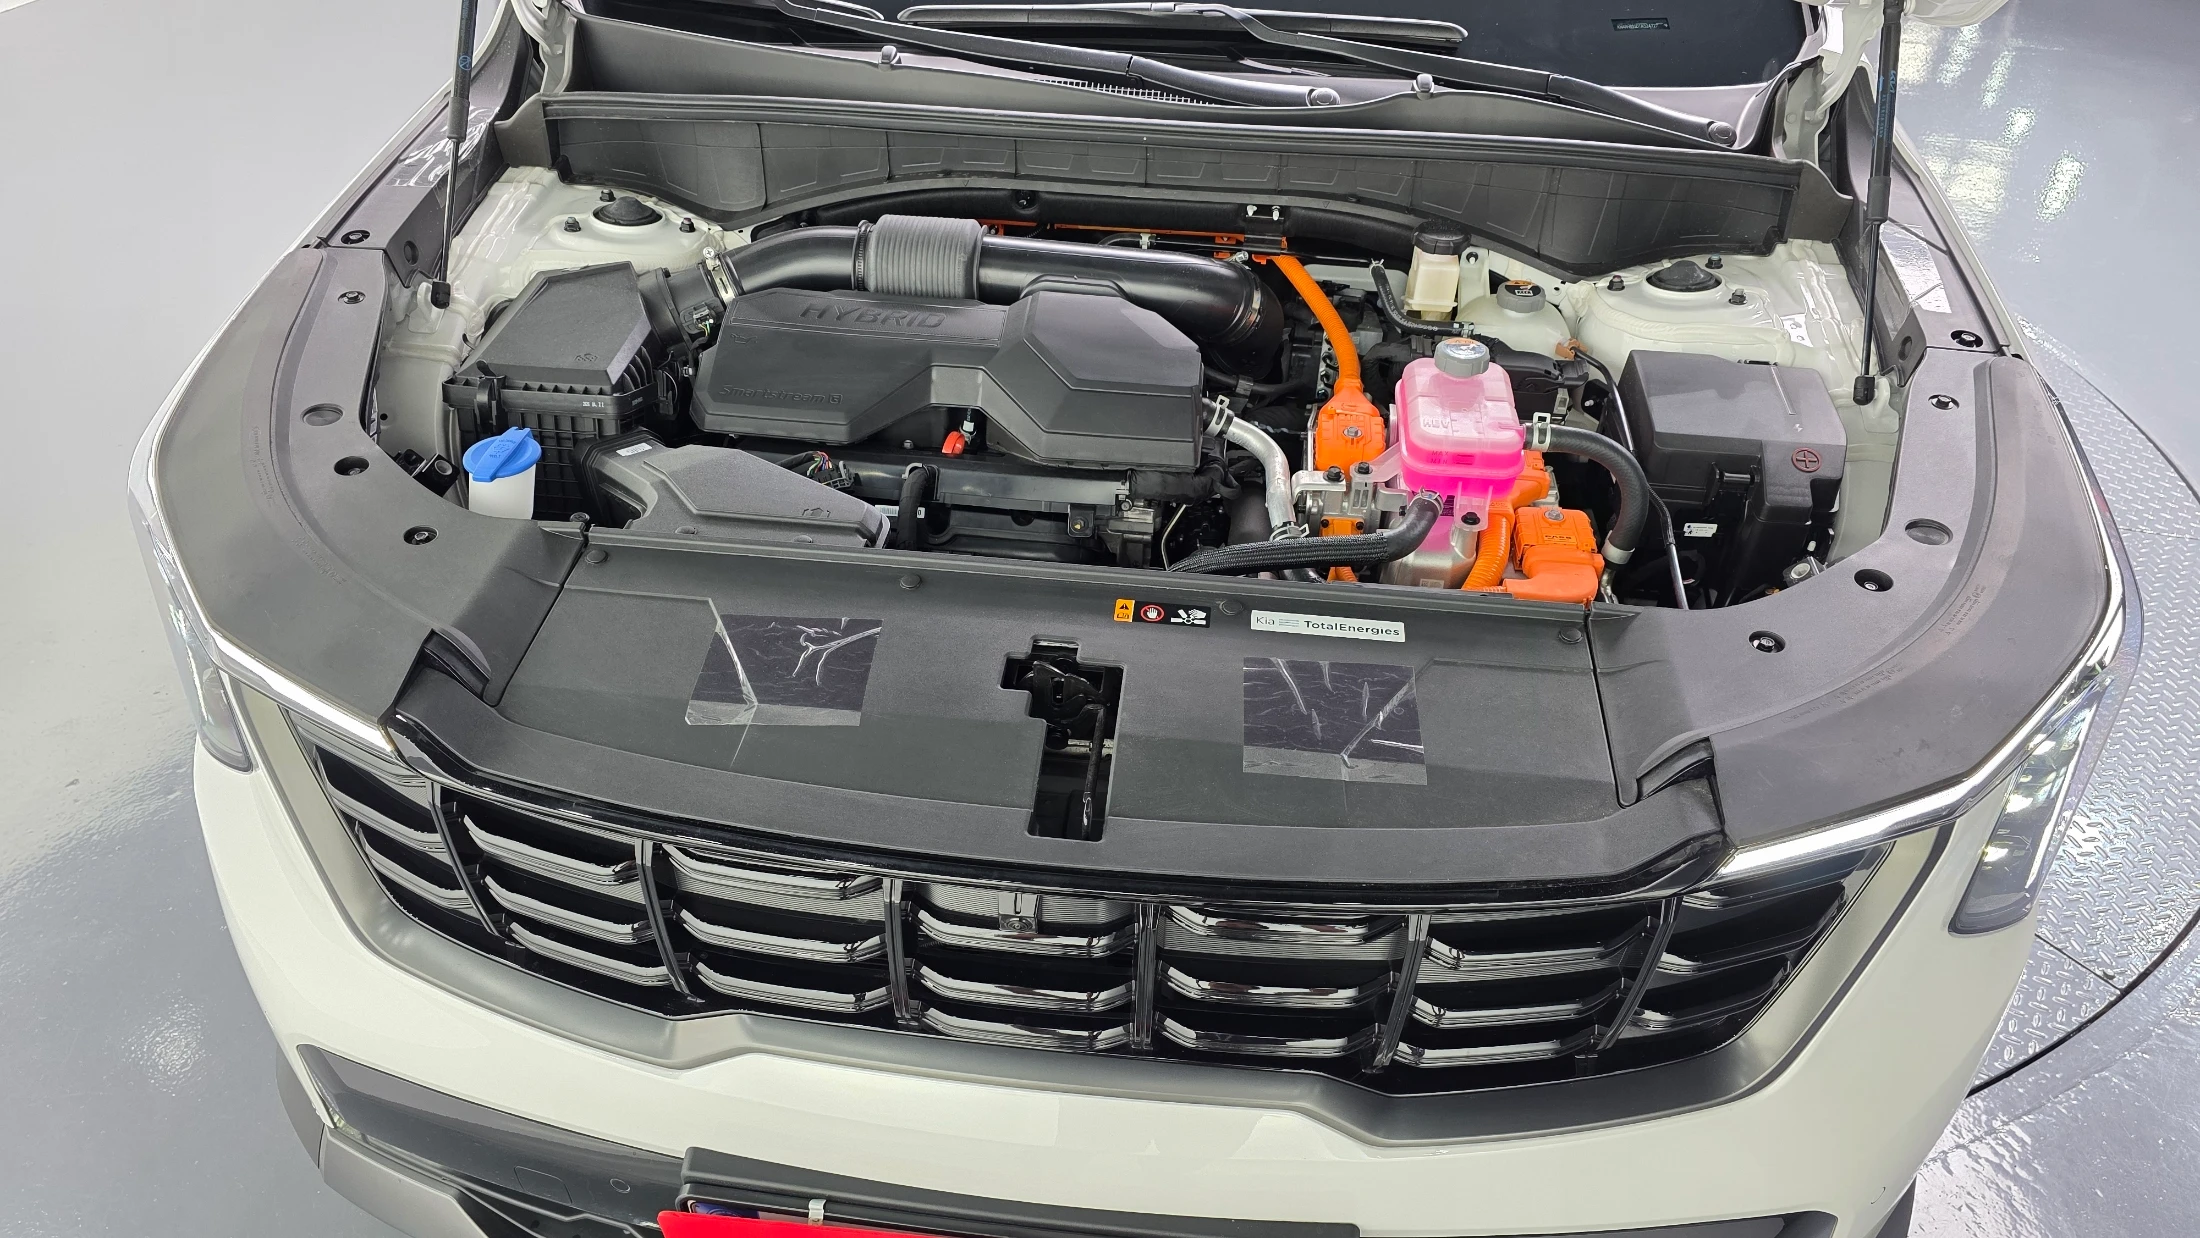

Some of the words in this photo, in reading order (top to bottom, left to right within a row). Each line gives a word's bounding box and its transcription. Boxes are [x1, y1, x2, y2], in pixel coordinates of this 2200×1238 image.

[799, 302, 947, 328] HYBRID
[719, 384, 827, 403] Smartstream
[1256, 616, 1275, 625] Kia
[1303, 620, 1400, 636] TotalEnergies
